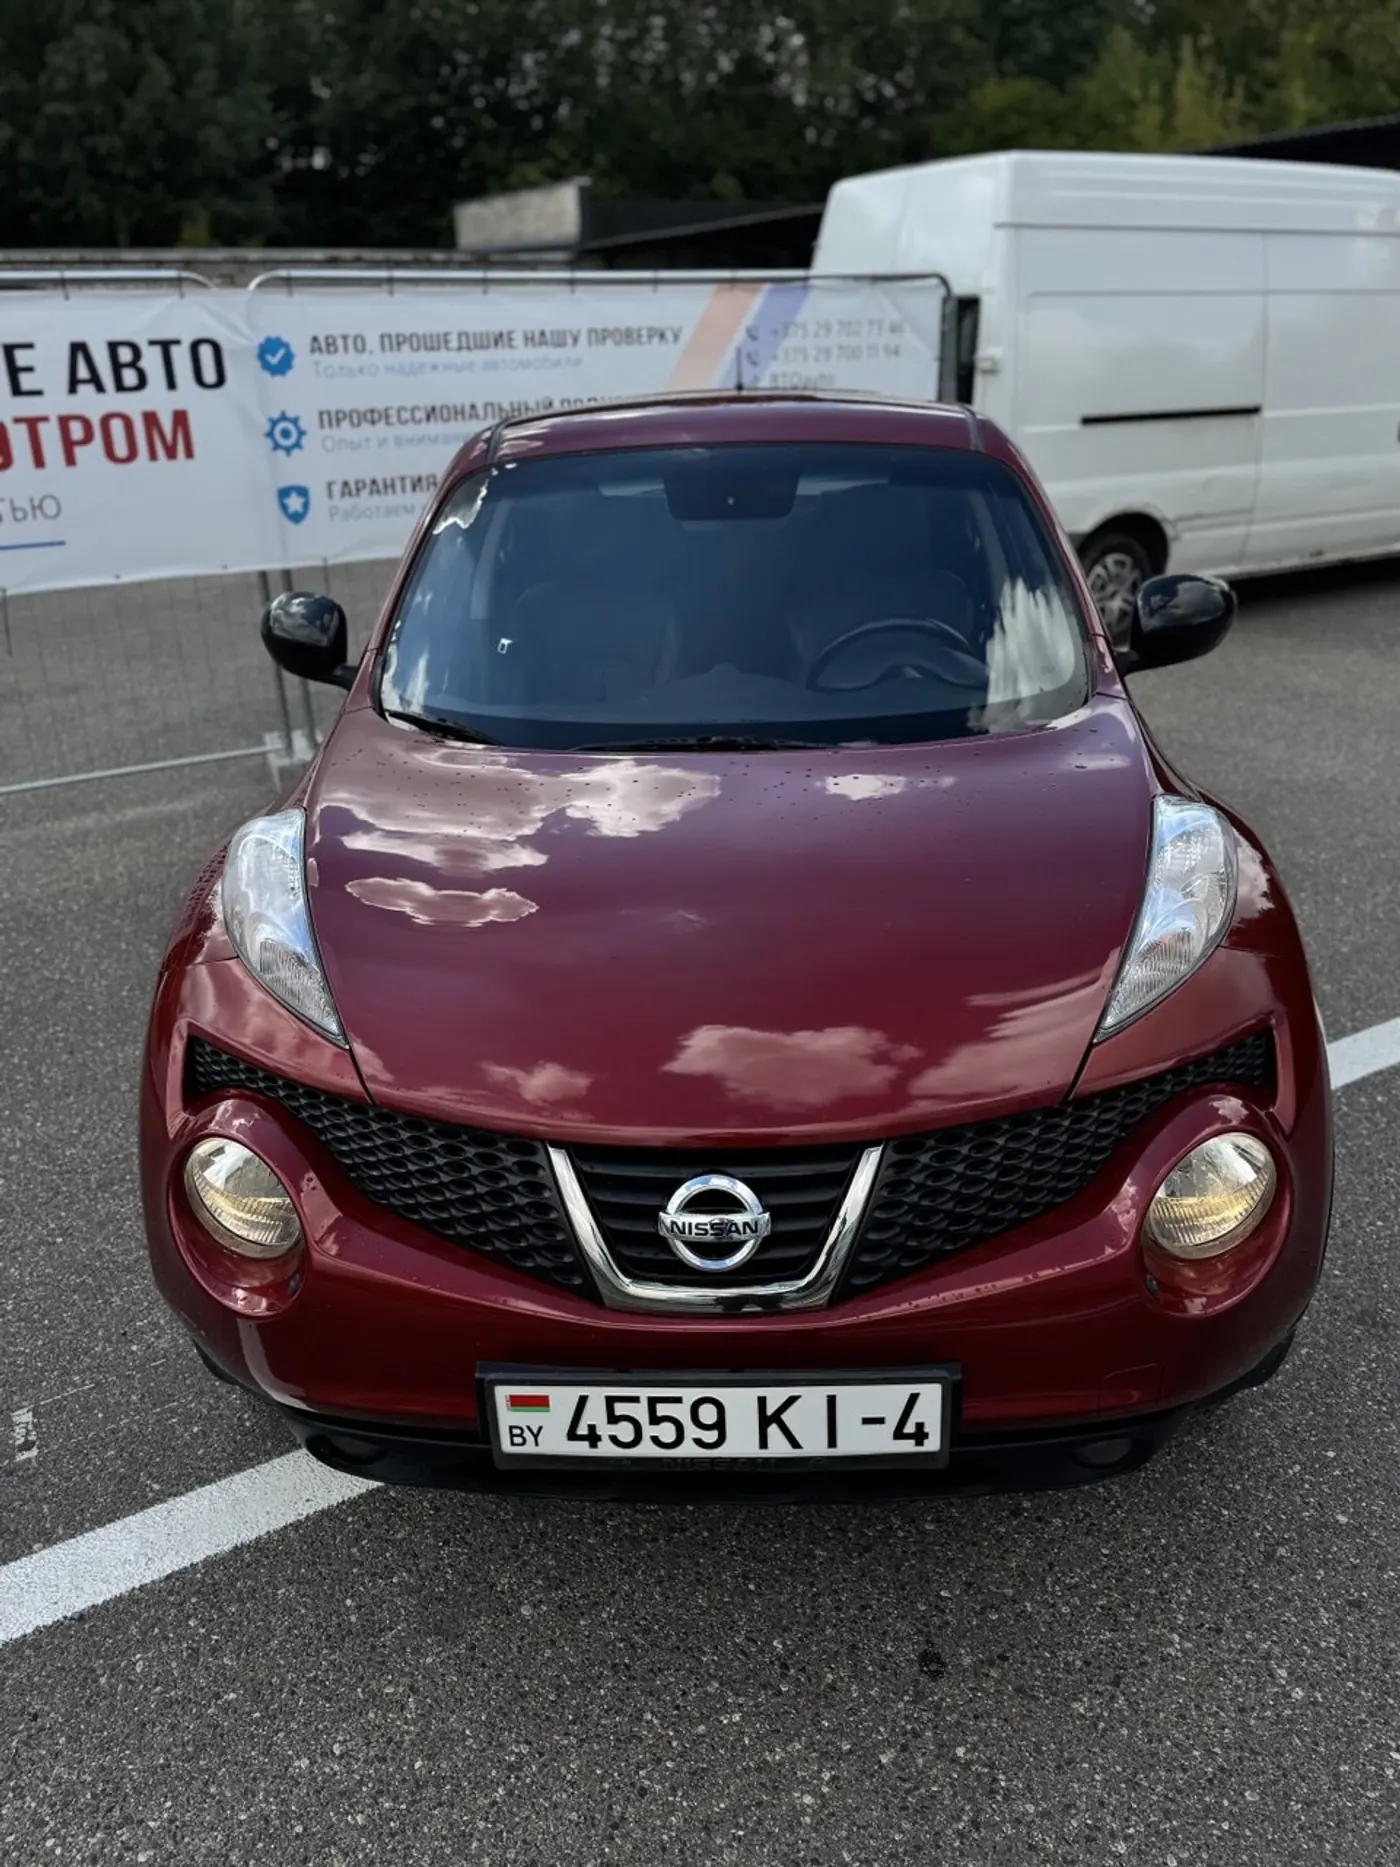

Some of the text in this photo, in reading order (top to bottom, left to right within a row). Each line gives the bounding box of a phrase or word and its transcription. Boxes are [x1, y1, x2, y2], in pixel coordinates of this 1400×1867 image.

[379, 329, 517, 354] ПРОШЕДШИЕ
[522, 327, 582, 349] НАШУ
[587, 325, 684, 347] ПРОВЕРКУ
[67, 337, 227, 395] АВТО
[312, 359, 380, 379] Только
[318, 397, 554, 430] ПРОФЕССИОНАЛЬНЫЙ
[321, 434, 371, 453] Опыт
[377, 435, 388, 449] и
[326, 473, 438, 500] ГАРАНТИЯ
[328, 503, 415, 522] Работаем
[670, 1220, 759, 1237] NISSAN
[508, 1425, 544, 1447] BY
[566, 1393, 727, 1451] 4559
